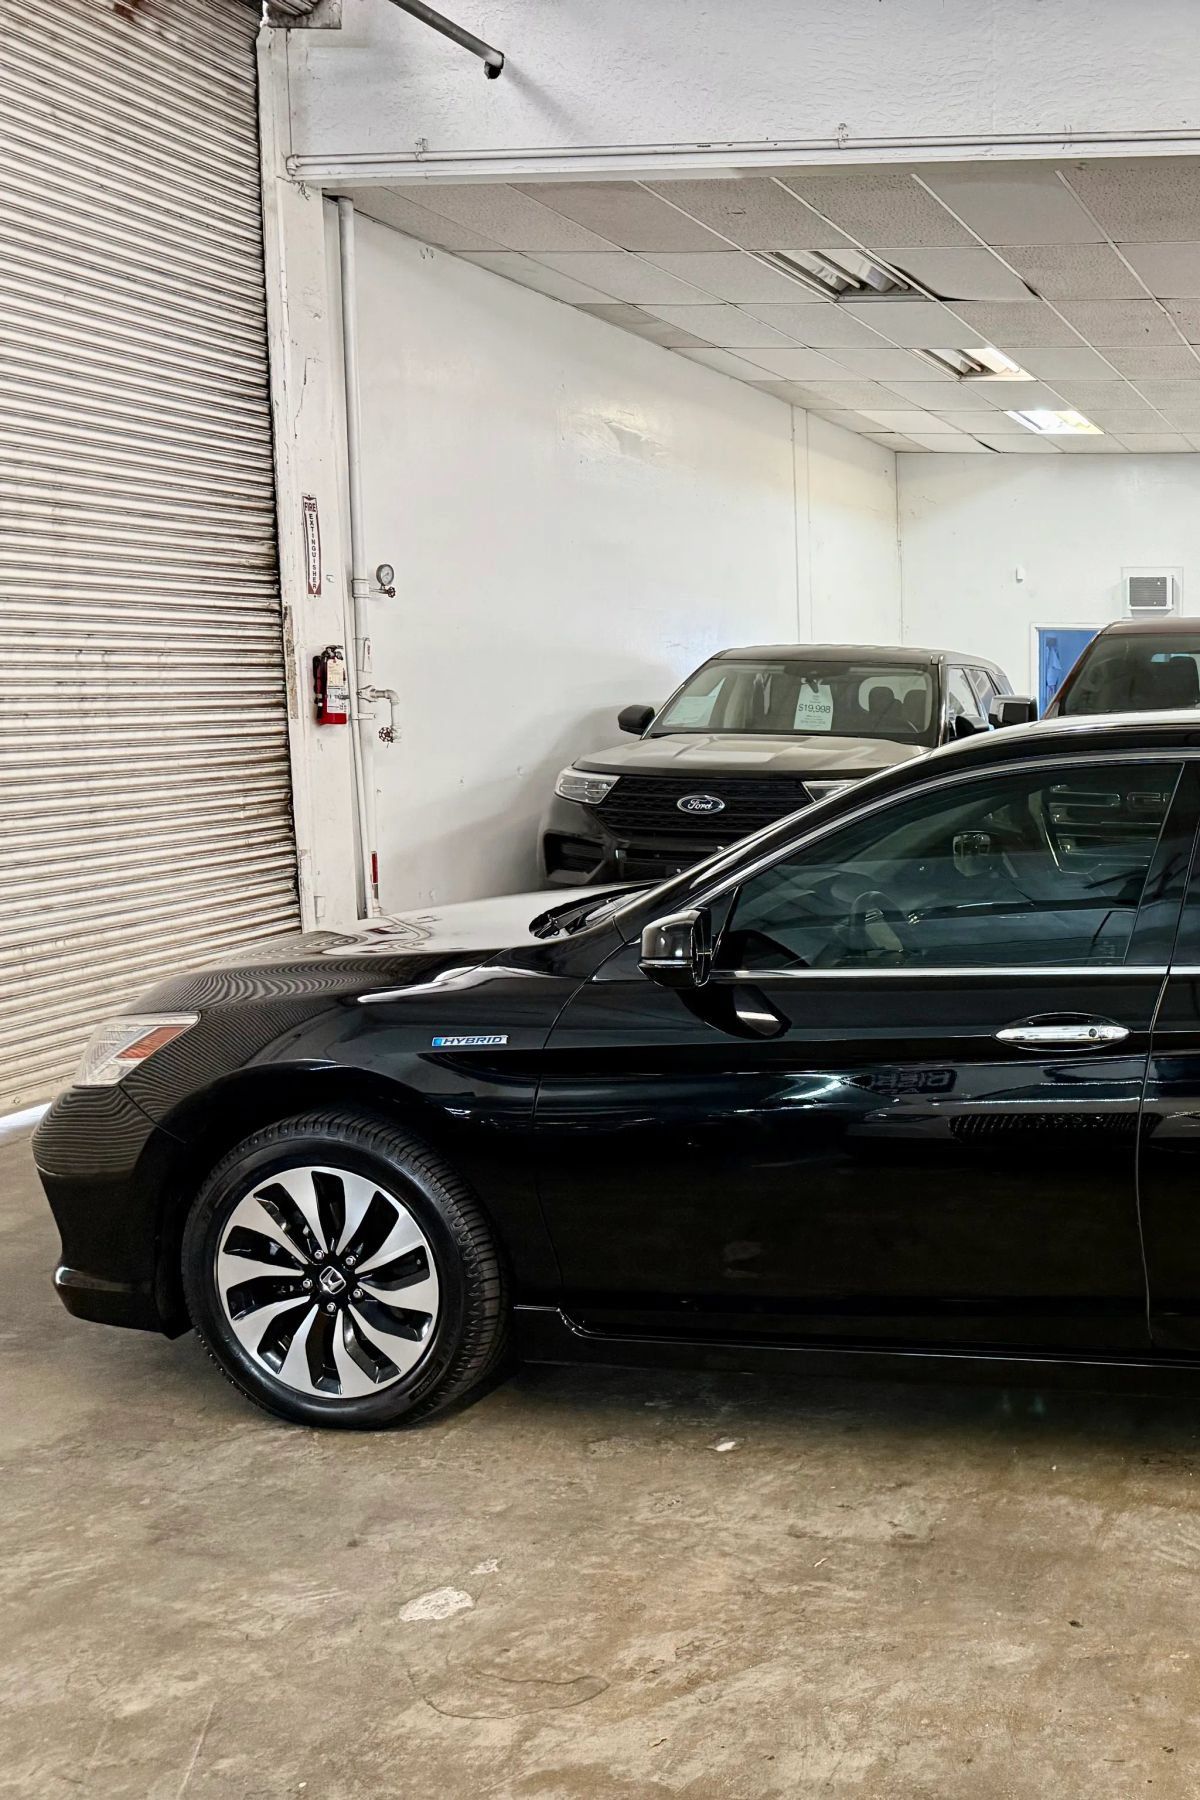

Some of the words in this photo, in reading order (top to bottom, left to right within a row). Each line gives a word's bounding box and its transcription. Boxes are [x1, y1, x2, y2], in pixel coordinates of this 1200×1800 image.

[304, 501, 316, 512] FIRE
[308, 513, 317, 589] EXTINGUISHER
[687, 798, 713, 810] Ford
[443, 1036, 503, 1045] HYBRID
